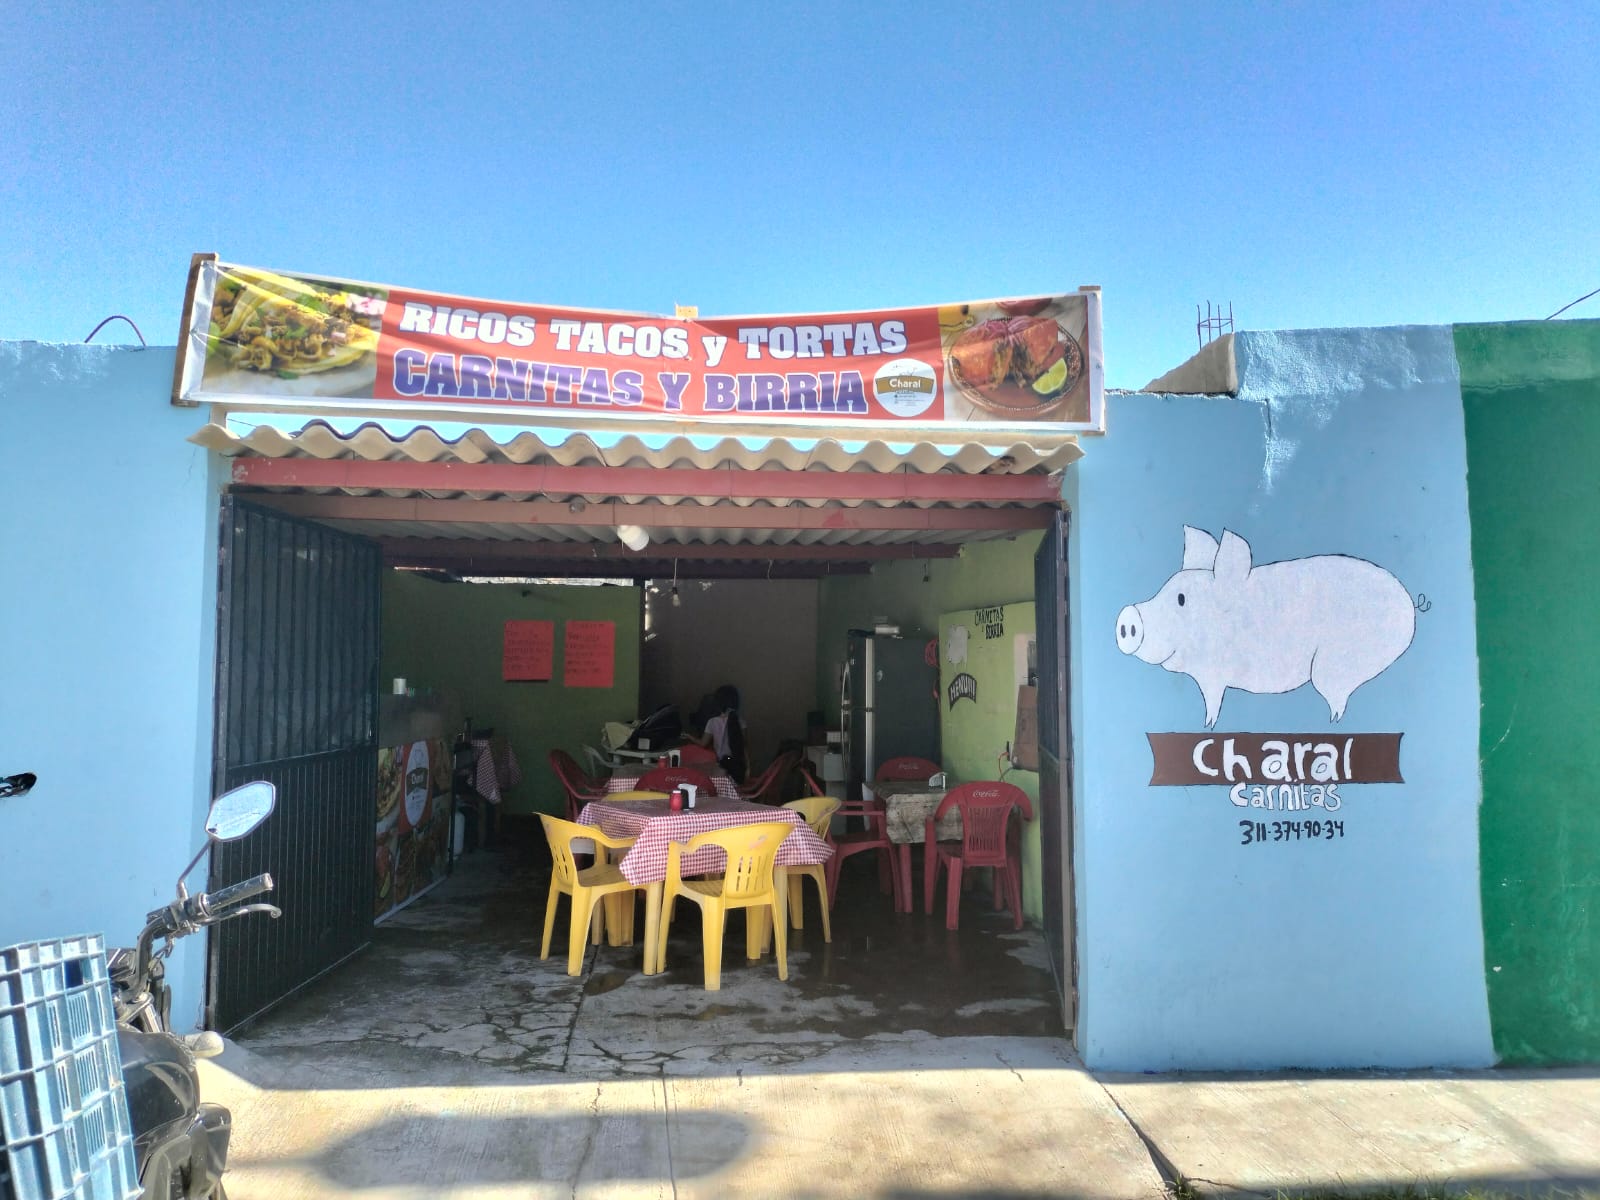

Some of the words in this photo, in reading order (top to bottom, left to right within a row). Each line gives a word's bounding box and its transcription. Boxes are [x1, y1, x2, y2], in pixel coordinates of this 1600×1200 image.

[399, 301, 536, 347] RICOS
[550, 319, 690, 359] TACOS
[701, 335, 728, 367] y
[738, 320, 908, 360] TORTAS
[392, 348, 645, 406] CARNITAS
[657, 372, 692, 412] Y
[703, 370, 869, 415] BIRRIA
[889, 378, 921, 389] Charal
[1192, 738, 1354, 782] Charal
[1238, 820, 1345, 846] 311-374-90-34
